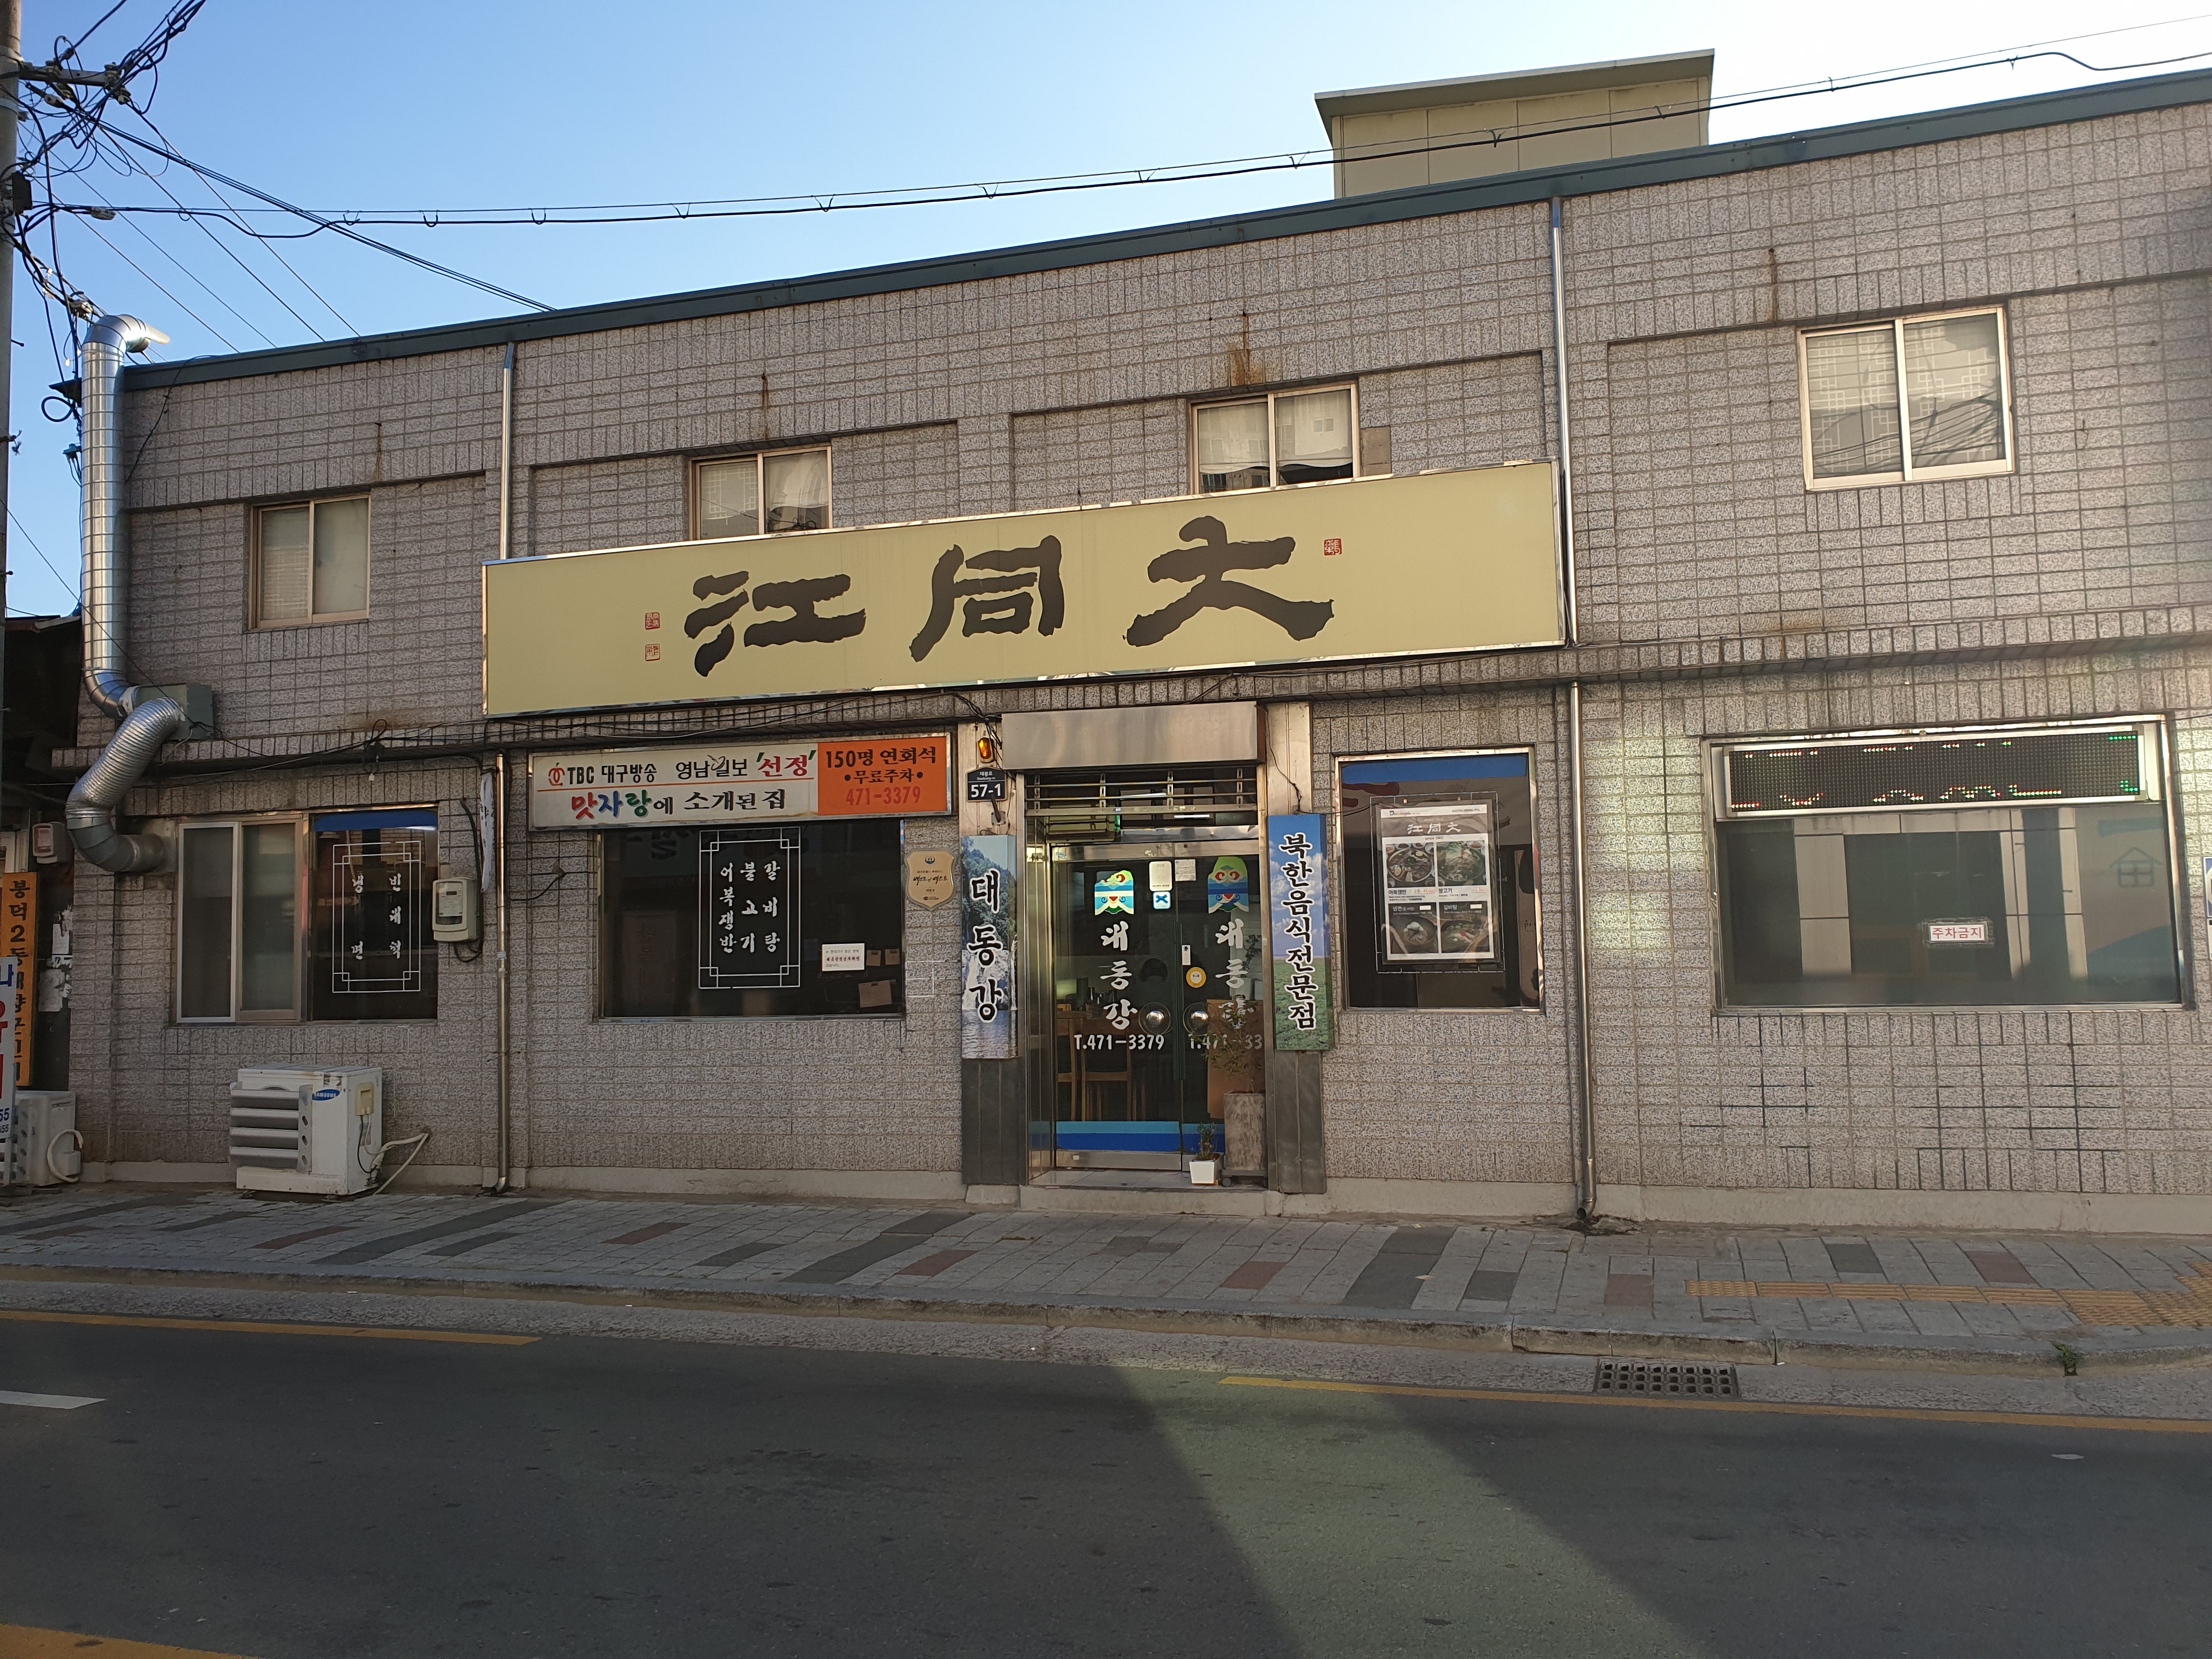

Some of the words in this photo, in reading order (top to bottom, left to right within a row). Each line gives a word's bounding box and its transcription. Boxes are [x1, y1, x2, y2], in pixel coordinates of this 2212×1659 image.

[567, 766, 594, 784] TBC
[602, 763, 657, 783] 대구방송
[826, 749, 873, 769] 150명
[880, 747, 936, 765] 연회석
[854, 769, 914, 785] 무료주차
[971, 783, 1001, 798] 57-1
[571, 789, 674, 820] 맛자랑에
[845, 786, 921, 806] 471-3379
[351, 874, 364, 960] 냉면
[719, 862, 737, 953] 어복쟁반
[740, 861, 758, 953] 불고기
[763, 860, 781, 953] 갈비탕
[968, 870, 1003, 1022] 대동강
[1280, 833, 1318, 1030] 북한음식전문점
[1932, 927, 1982, 939] 주차금지
[1100, 921, 1138, 1030] 대동강
[1074, 1034, 1164, 1050] T.471-3379
